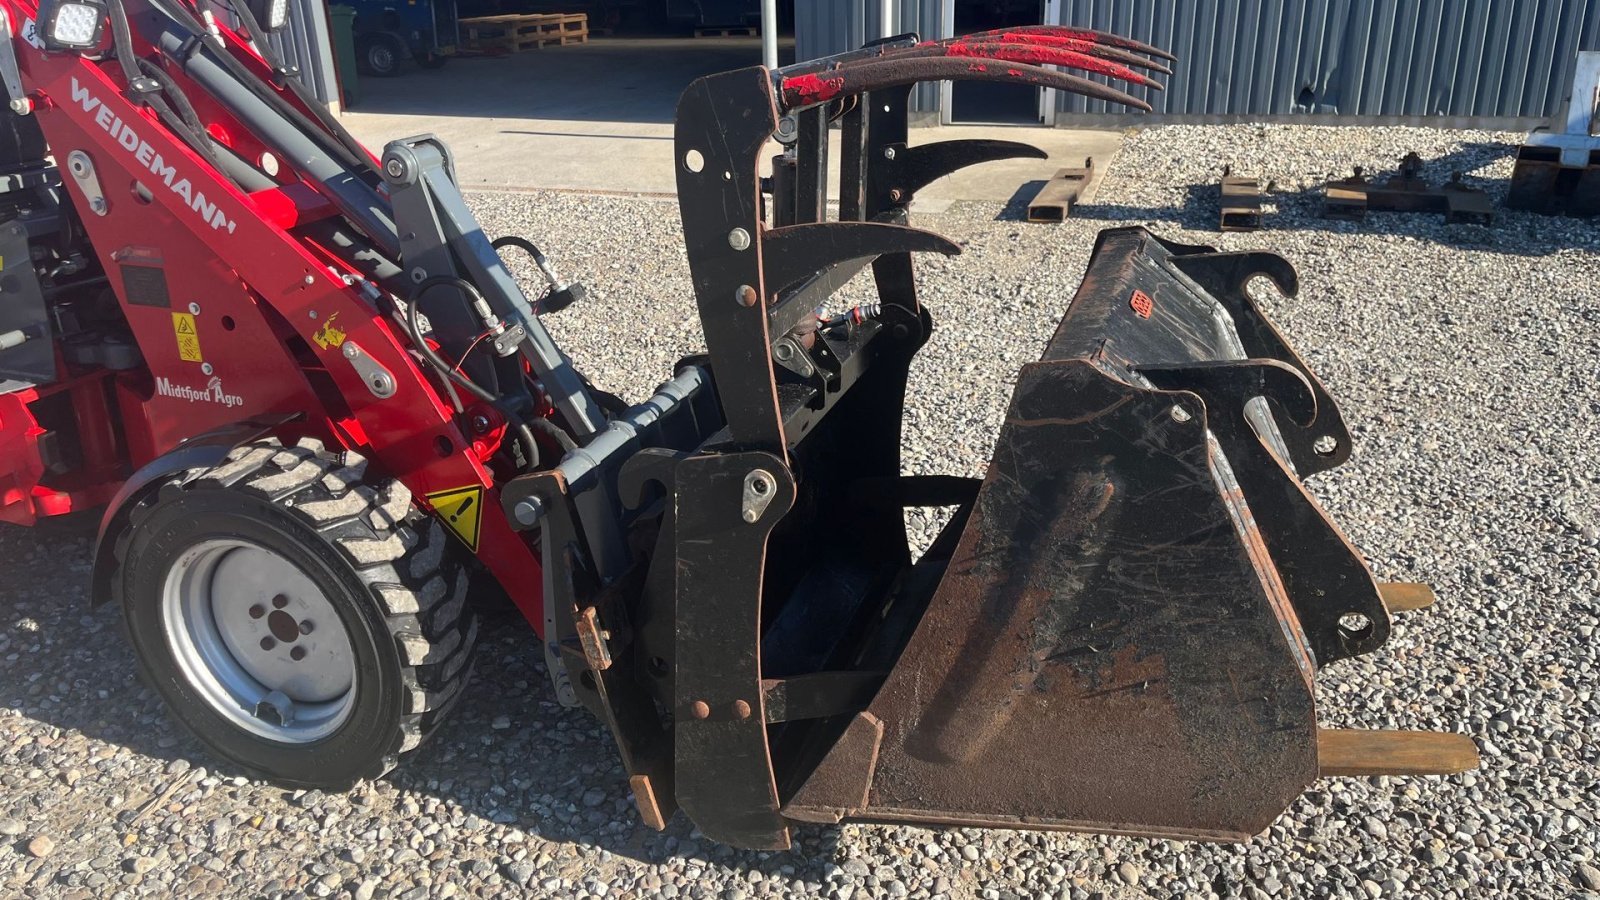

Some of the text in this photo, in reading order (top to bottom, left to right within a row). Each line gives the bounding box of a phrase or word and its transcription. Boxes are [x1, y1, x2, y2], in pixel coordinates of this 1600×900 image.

[71, 76, 237, 234] WEIDEMANN
[156, 376, 244, 408] Midtfjord Agro
